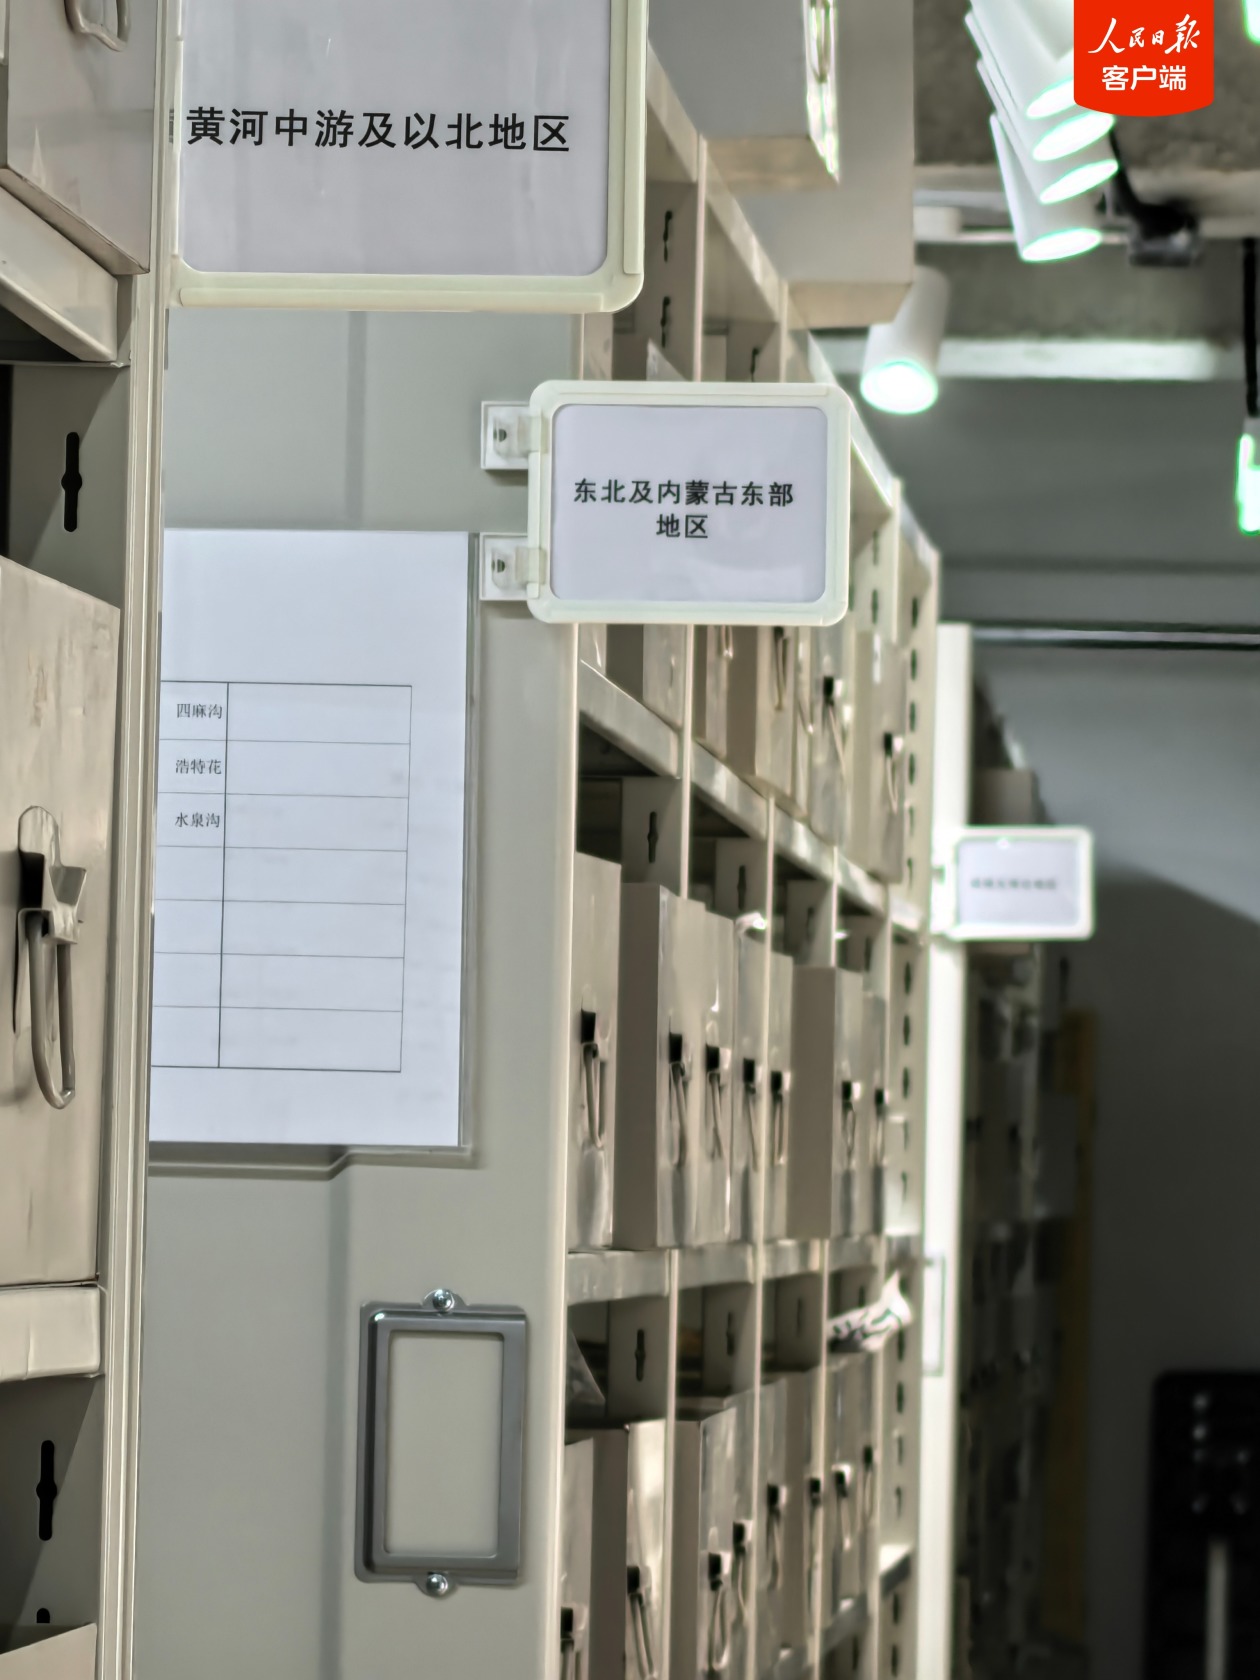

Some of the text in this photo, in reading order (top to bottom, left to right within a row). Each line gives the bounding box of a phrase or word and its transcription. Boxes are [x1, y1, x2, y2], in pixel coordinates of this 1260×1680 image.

[186, 106, 570, 152] 黄河中游及以北地区
[573, 477, 794, 508] 东北及内蒙古东部
[656, 512, 709, 539] 地区
[176, 703, 223, 720] 四麻沟
[175, 758, 222, 775] 浩特花
[174, 812, 221, 828] 水泉沟
